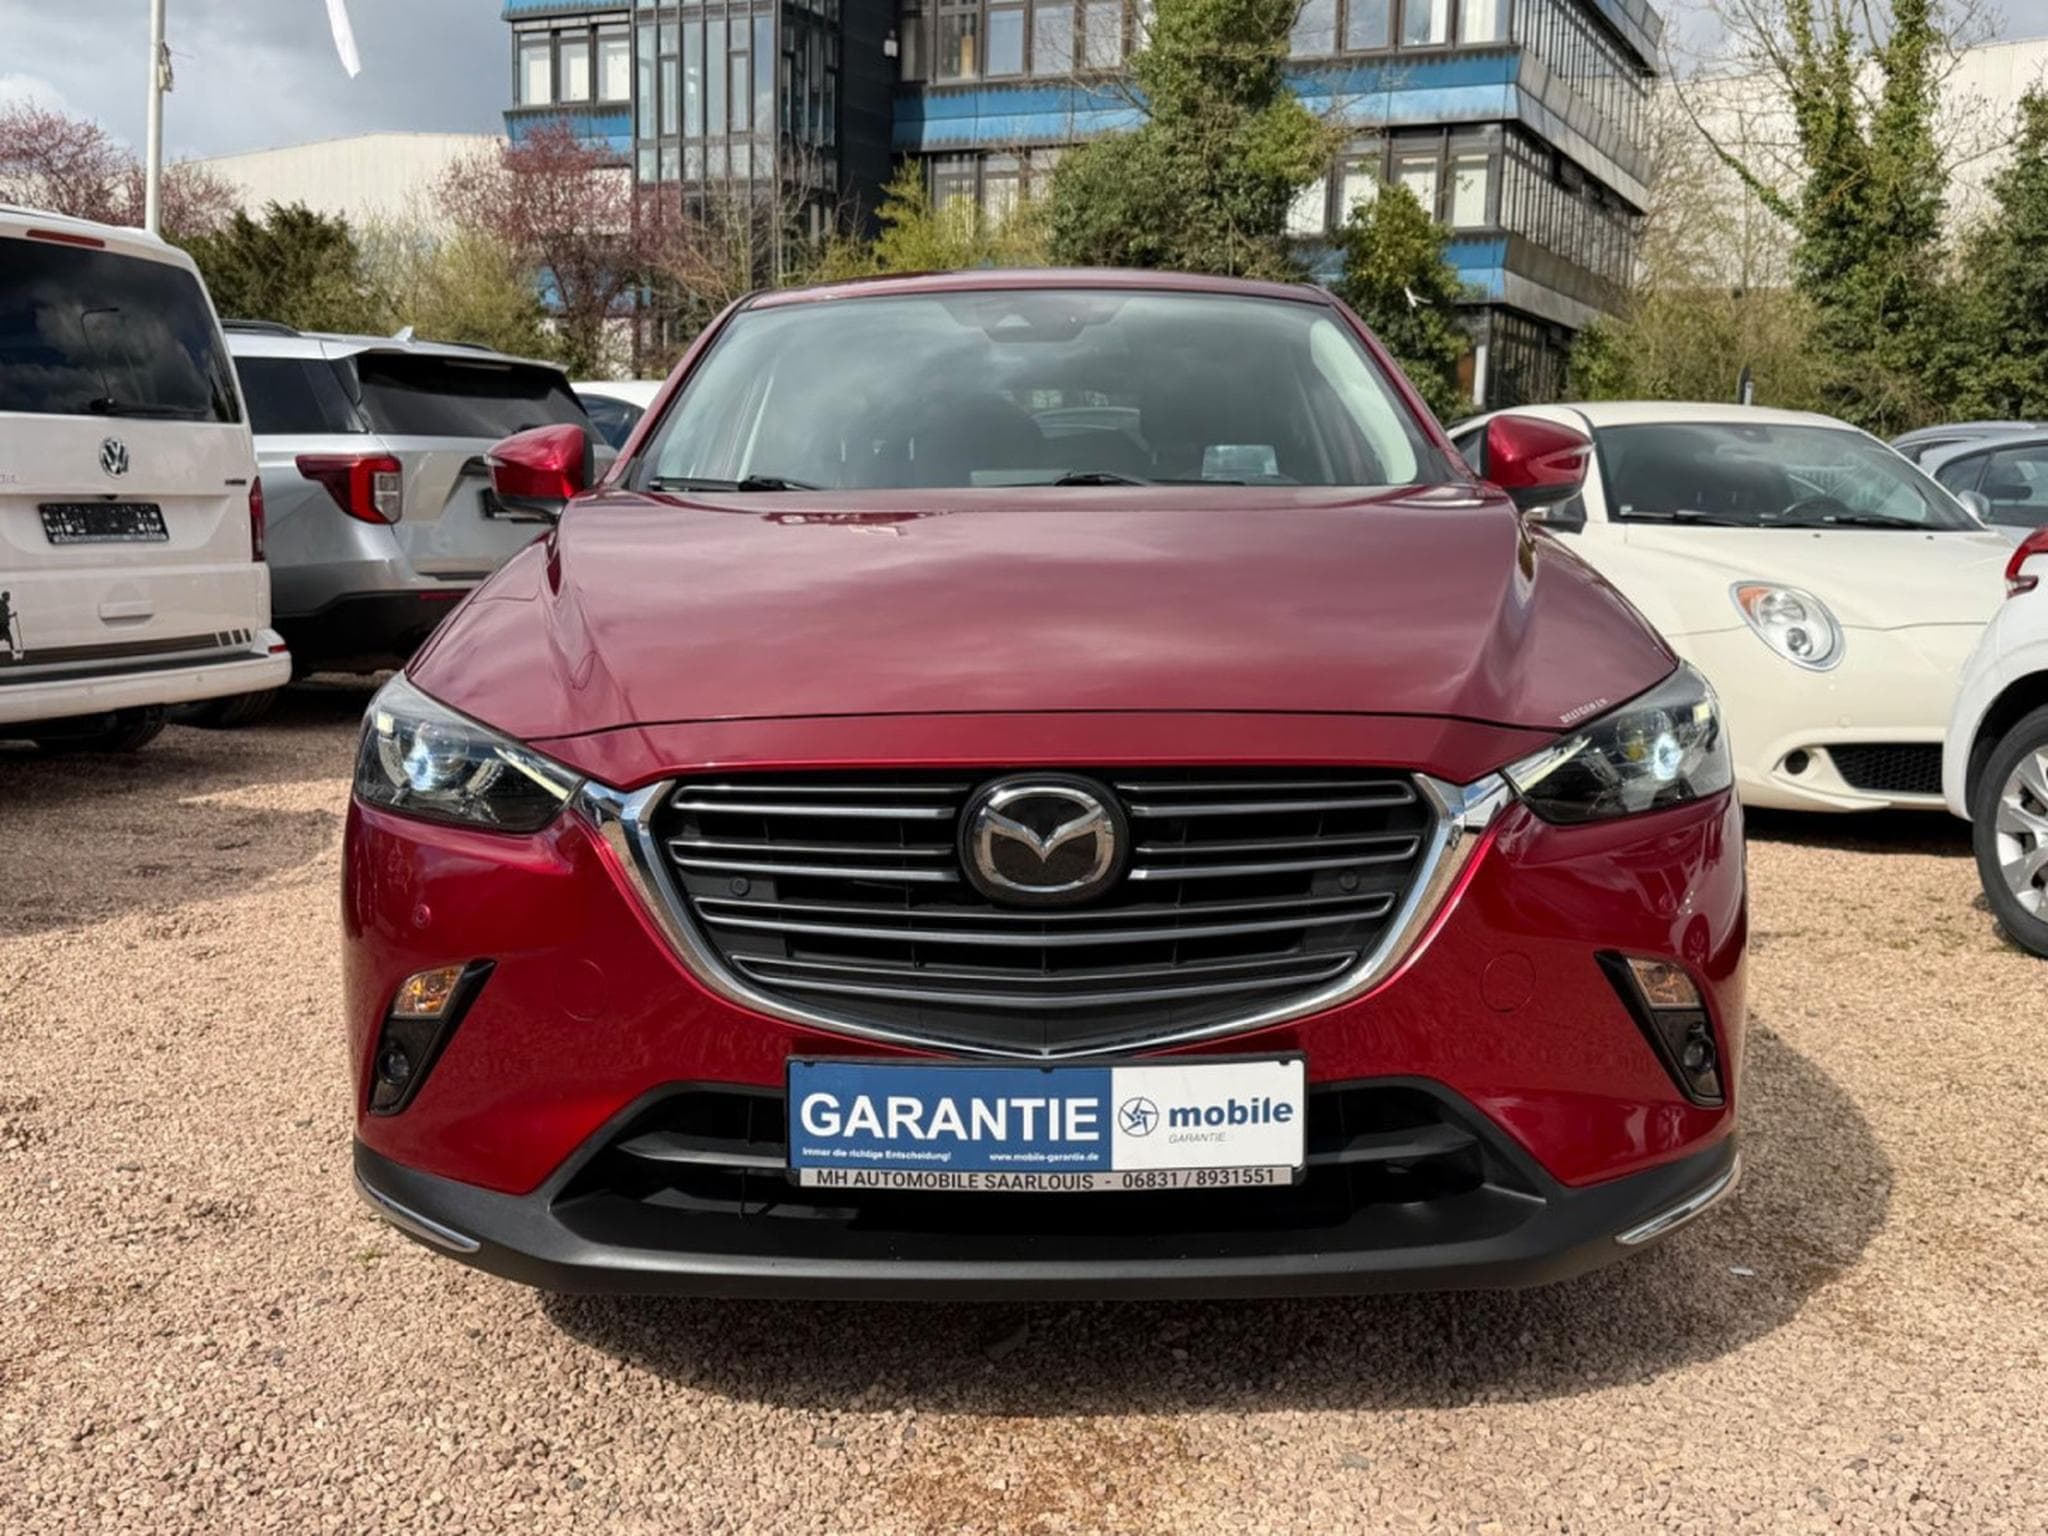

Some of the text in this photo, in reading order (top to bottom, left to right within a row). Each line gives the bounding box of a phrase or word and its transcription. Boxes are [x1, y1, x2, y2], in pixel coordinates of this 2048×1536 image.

[801, 1092, 1099, 1141] GARANTIE
[1168, 1098, 1293, 1127] mobile
[1168, 1132, 1226, 1144] GARANTIE
[802, 1147, 952, 1163] Immer die richtige Entscheidung!
[989, 1152, 1099, 1163] www.mobile-garantie.de
[816, 1170, 848, 1185] MH
[854, 1171, 979, 1188] AUTOMOBILE
[985, 1174, 1094, 1190] SAARLOUIS
[1122, 1172, 1178, 1188] 06831
[1196, 1168, 1274, 1185] 8931551
